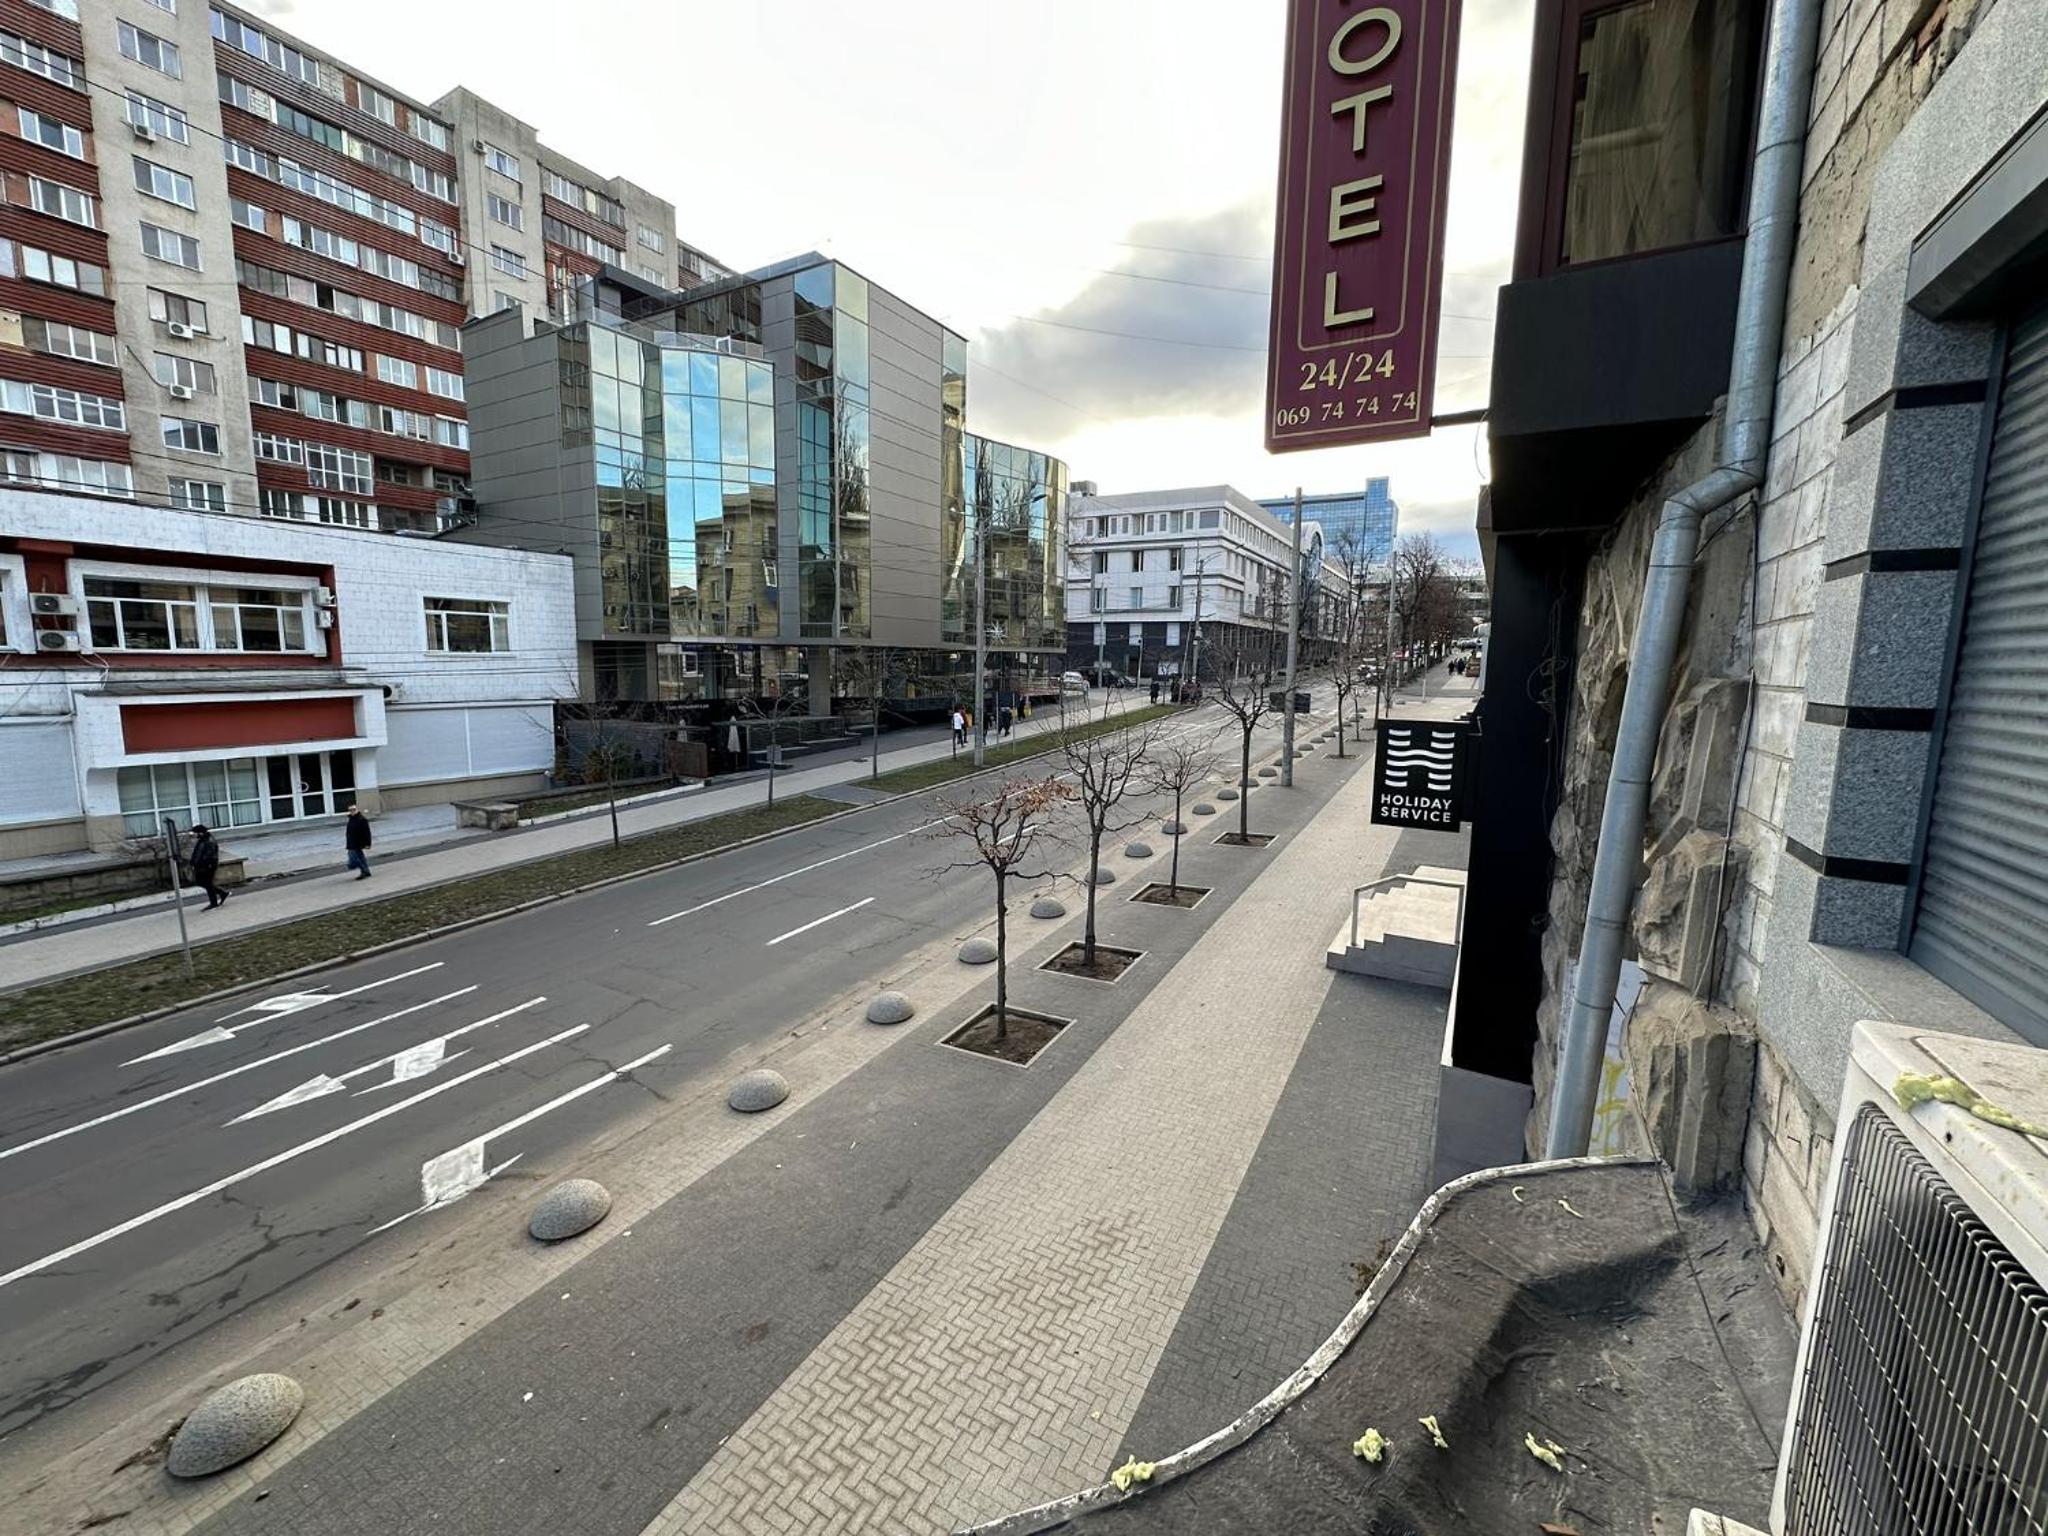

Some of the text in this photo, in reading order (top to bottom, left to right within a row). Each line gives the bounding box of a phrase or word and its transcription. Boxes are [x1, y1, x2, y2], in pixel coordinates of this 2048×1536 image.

[1323, 0, 1402, 328] OTEL
[1299, 348, 1395, 391] 24/24
[1277, 391, 1417, 427] 069 74 74 74
[1380, 793, 1452, 810] HOLIDAY
[1380, 806, 1452, 823] SERVICE
